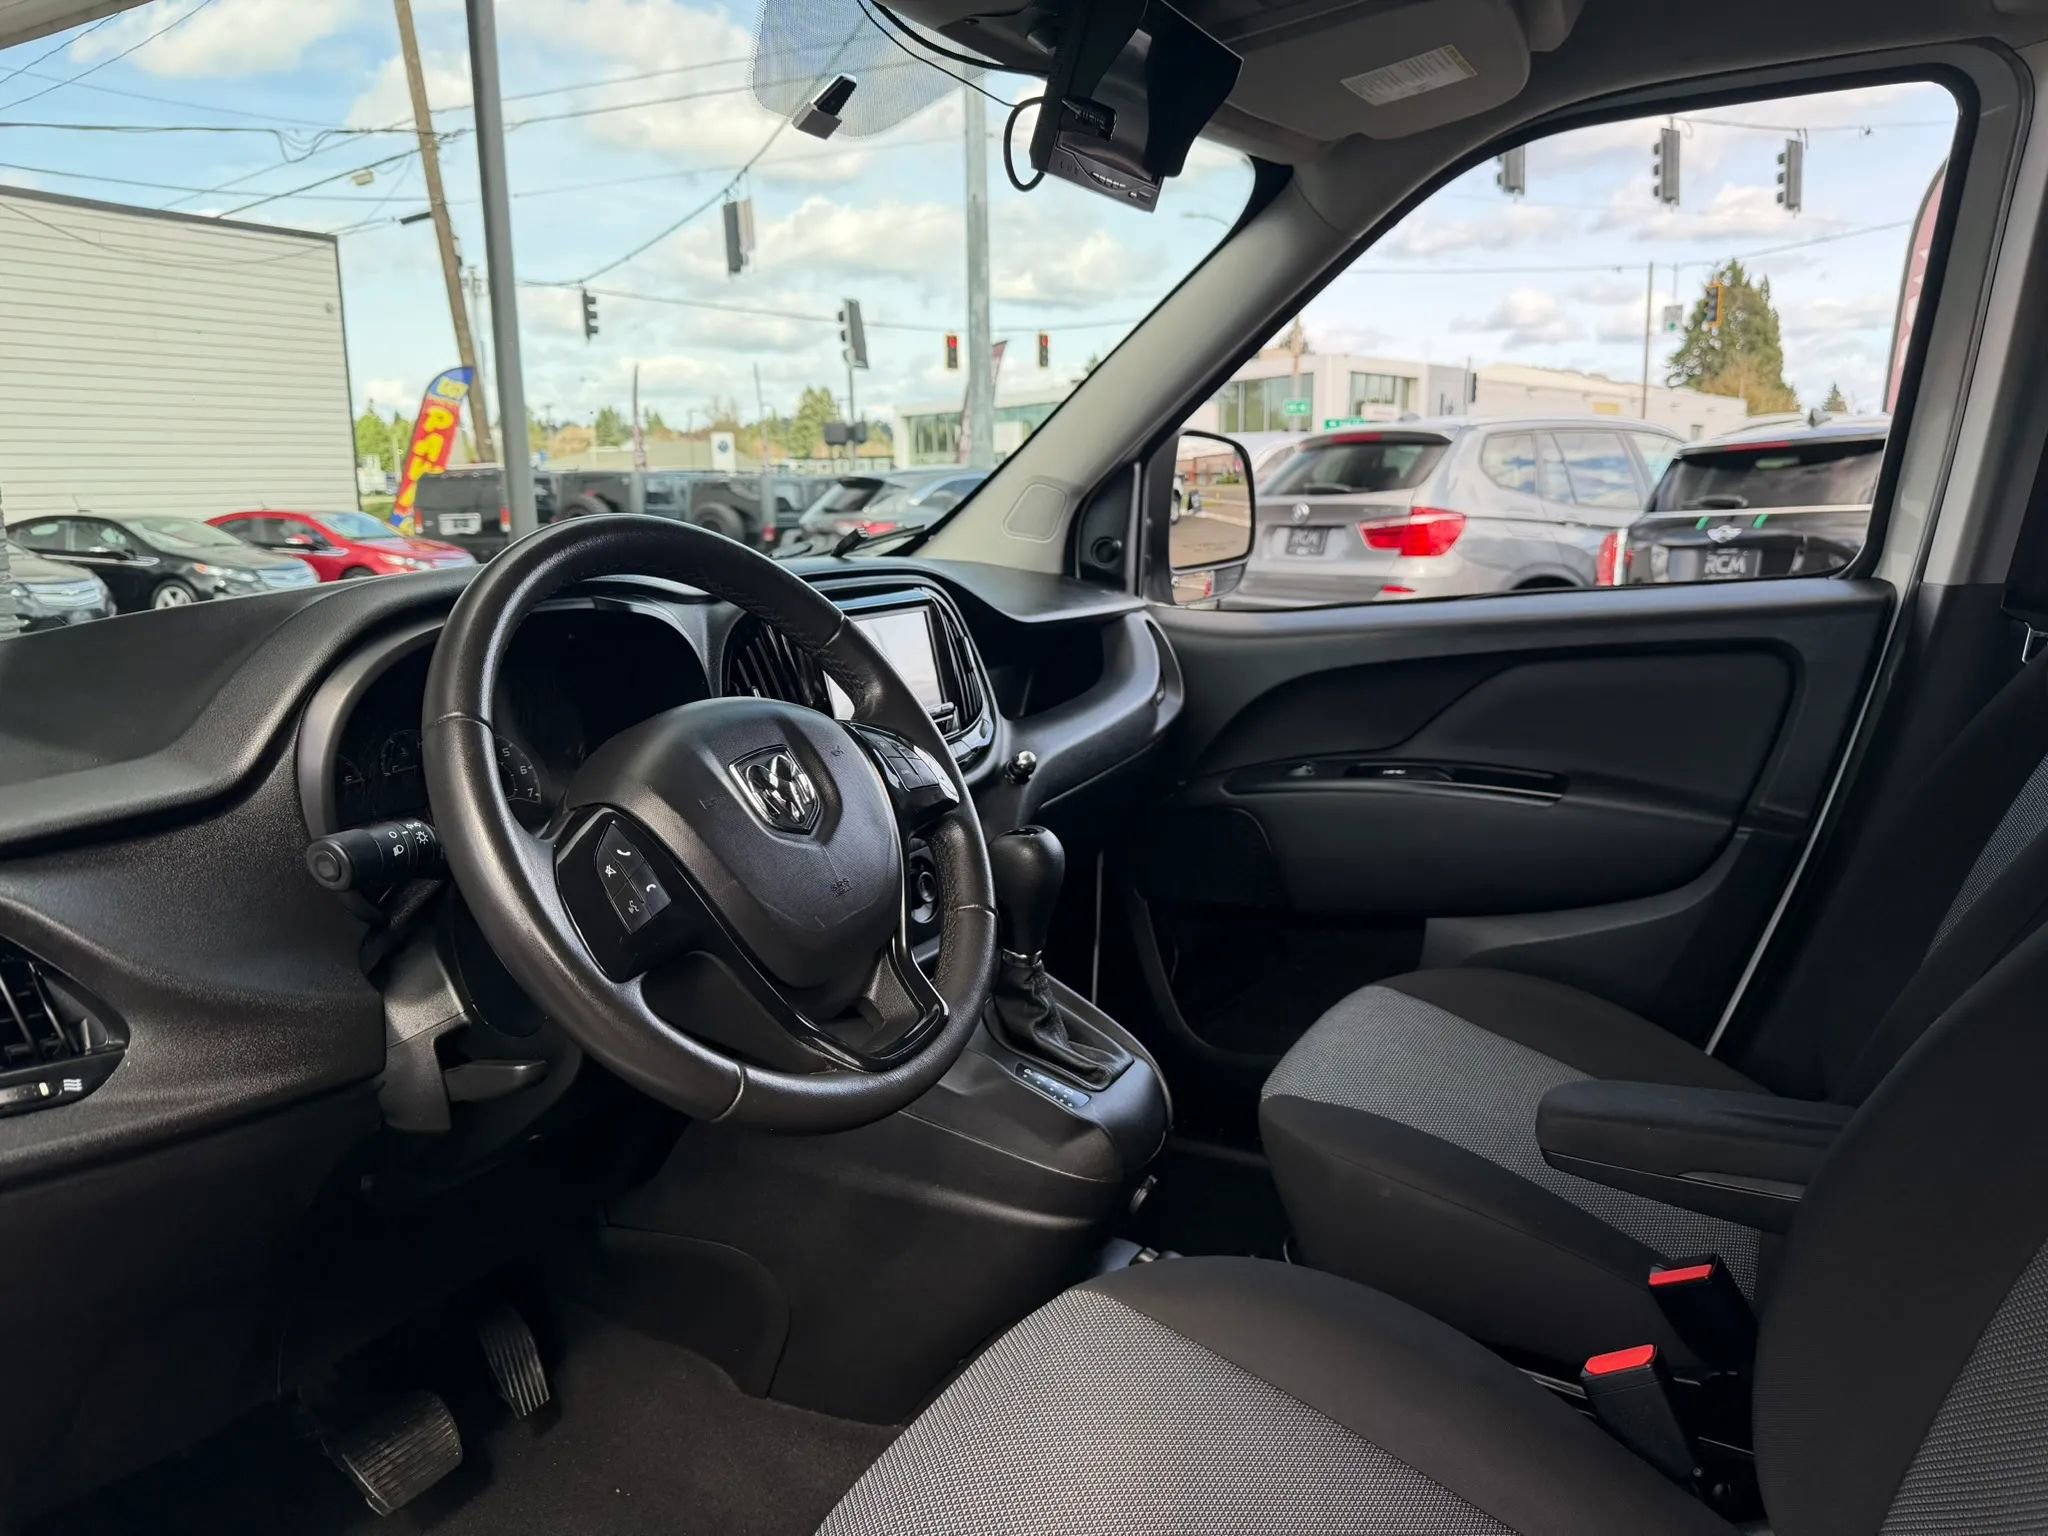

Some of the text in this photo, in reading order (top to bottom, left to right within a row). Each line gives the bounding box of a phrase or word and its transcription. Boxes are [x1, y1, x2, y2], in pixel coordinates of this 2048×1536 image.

[1704, 554, 1747, 574] RCM
[519, 766, 528, 775] 6
[527, 788, 535, 798] 7
